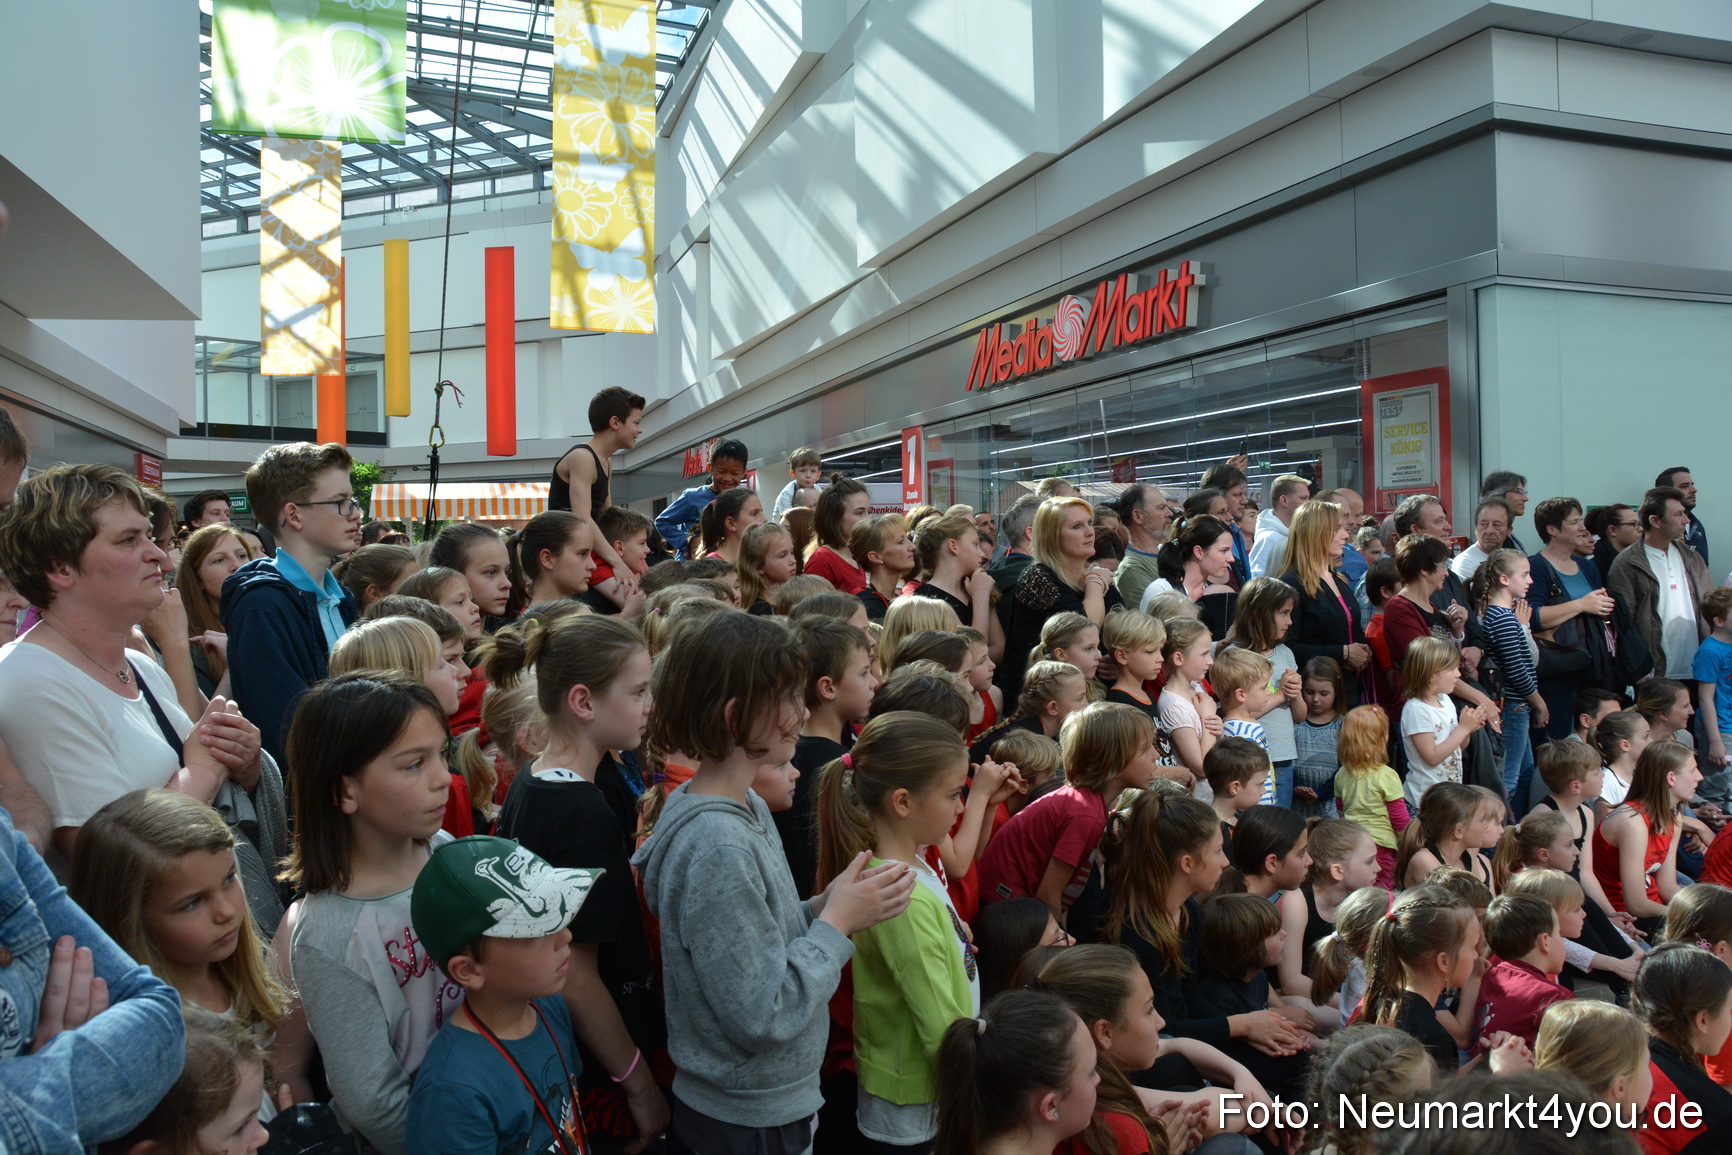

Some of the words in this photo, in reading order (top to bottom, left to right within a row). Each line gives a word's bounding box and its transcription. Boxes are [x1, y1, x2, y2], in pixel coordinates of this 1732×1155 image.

[965, 317, 1054, 391] Media
[1074, 260, 1198, 358] Markt
[1380, 404, 1402, 417] TEST
[1384, 421, 1428, 439] SERVICE
[1390, 440, 1422, 455] KÖNIG
[907, 435, 917, 485] 1
